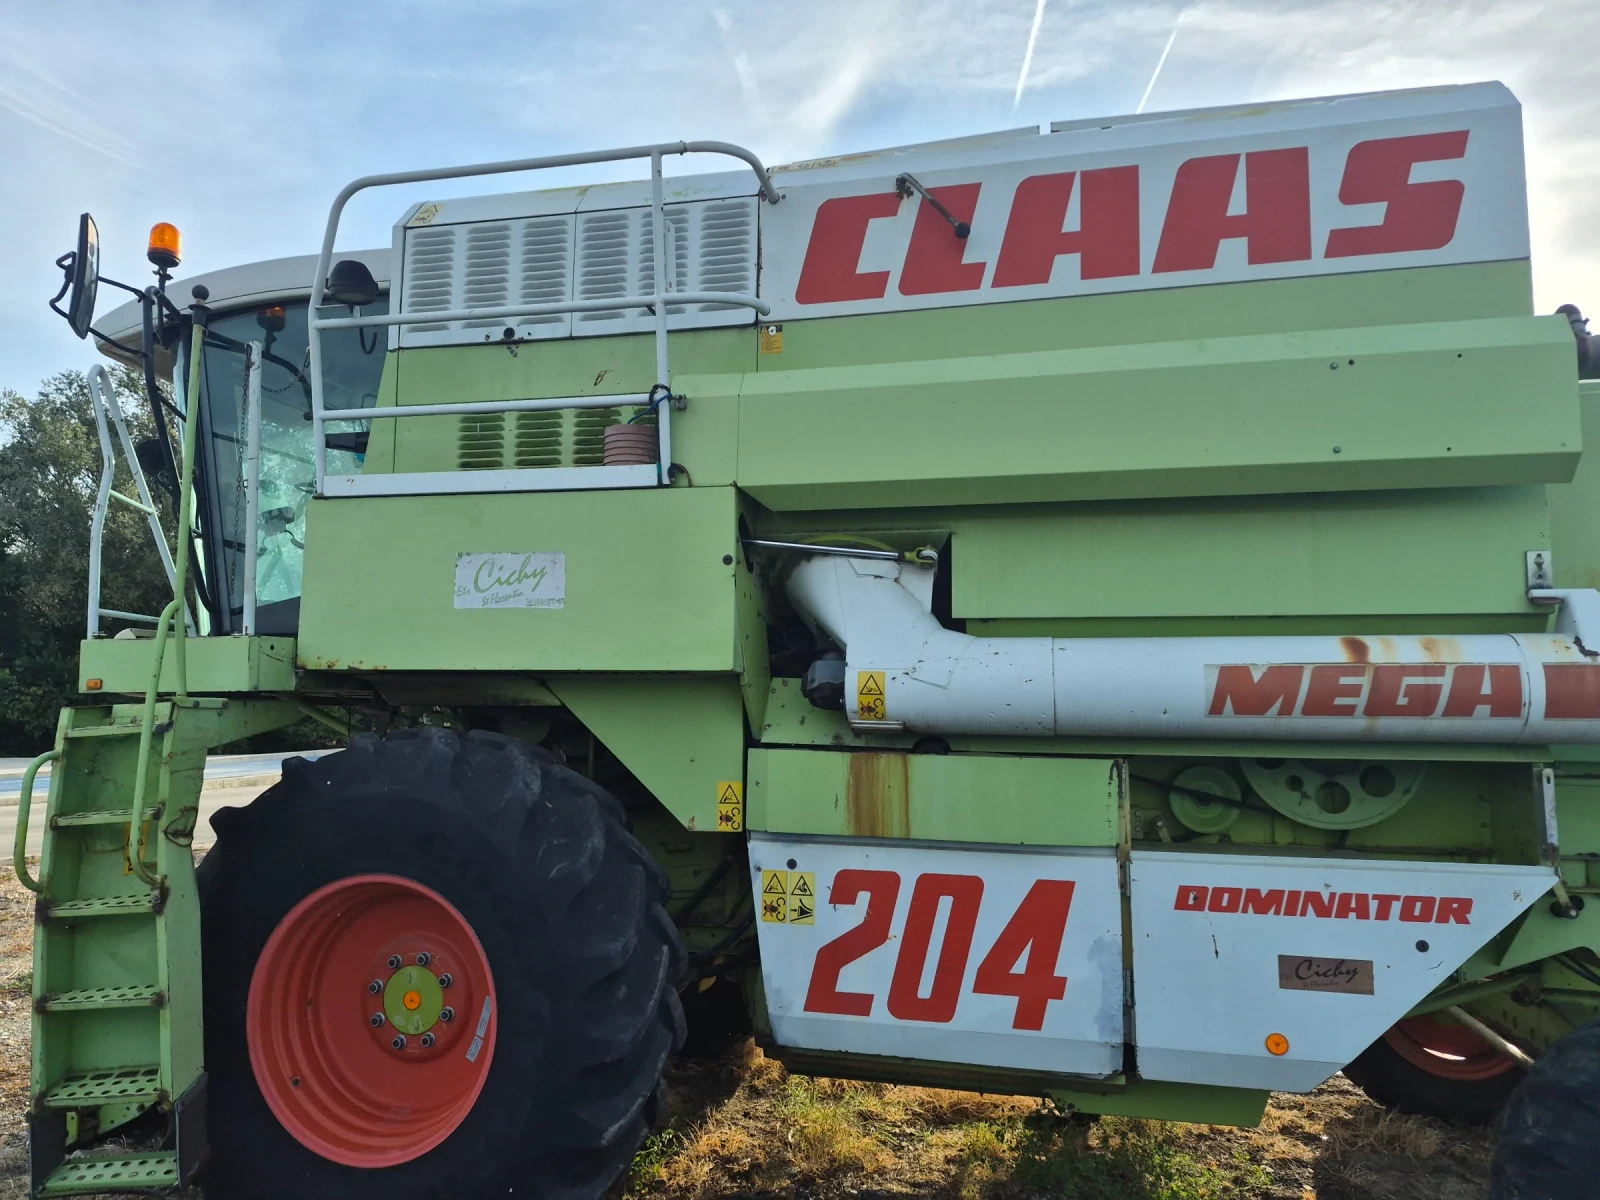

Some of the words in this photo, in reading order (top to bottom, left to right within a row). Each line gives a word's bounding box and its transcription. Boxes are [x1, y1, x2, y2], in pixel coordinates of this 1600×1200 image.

[794, 129, 1470, 305] CLAAS
[473, 554, 547, 593] Cichy
[1208, 664, 1522, 718] MEGA
[1173, 885, 1474, 925] DOMINATOR
[803, 868, 1076, 1031] 204
[1295, 959, 1359, 984] Cichy
